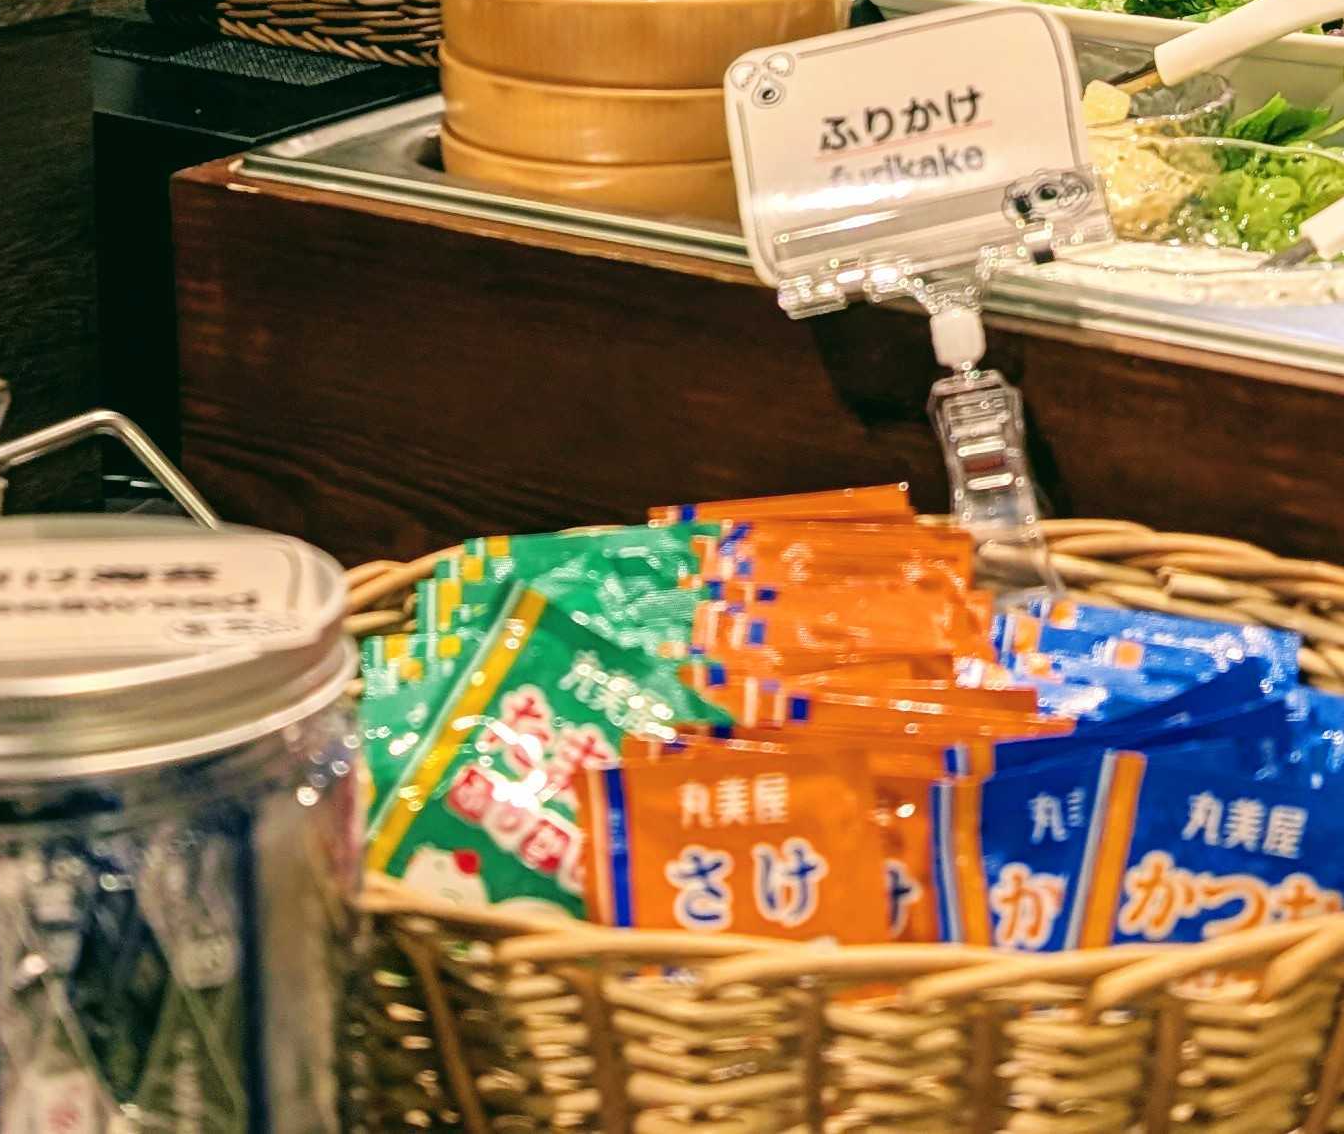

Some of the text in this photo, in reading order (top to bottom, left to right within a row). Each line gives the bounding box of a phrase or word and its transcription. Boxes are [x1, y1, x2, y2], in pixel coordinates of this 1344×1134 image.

[820, 85, 983, 152] ふりかけ
[678, 772, 790, 829] 丸美屋
[1182, 790, 1310, 860] 丸美屋
[666, 835, 828, 932] さけ
